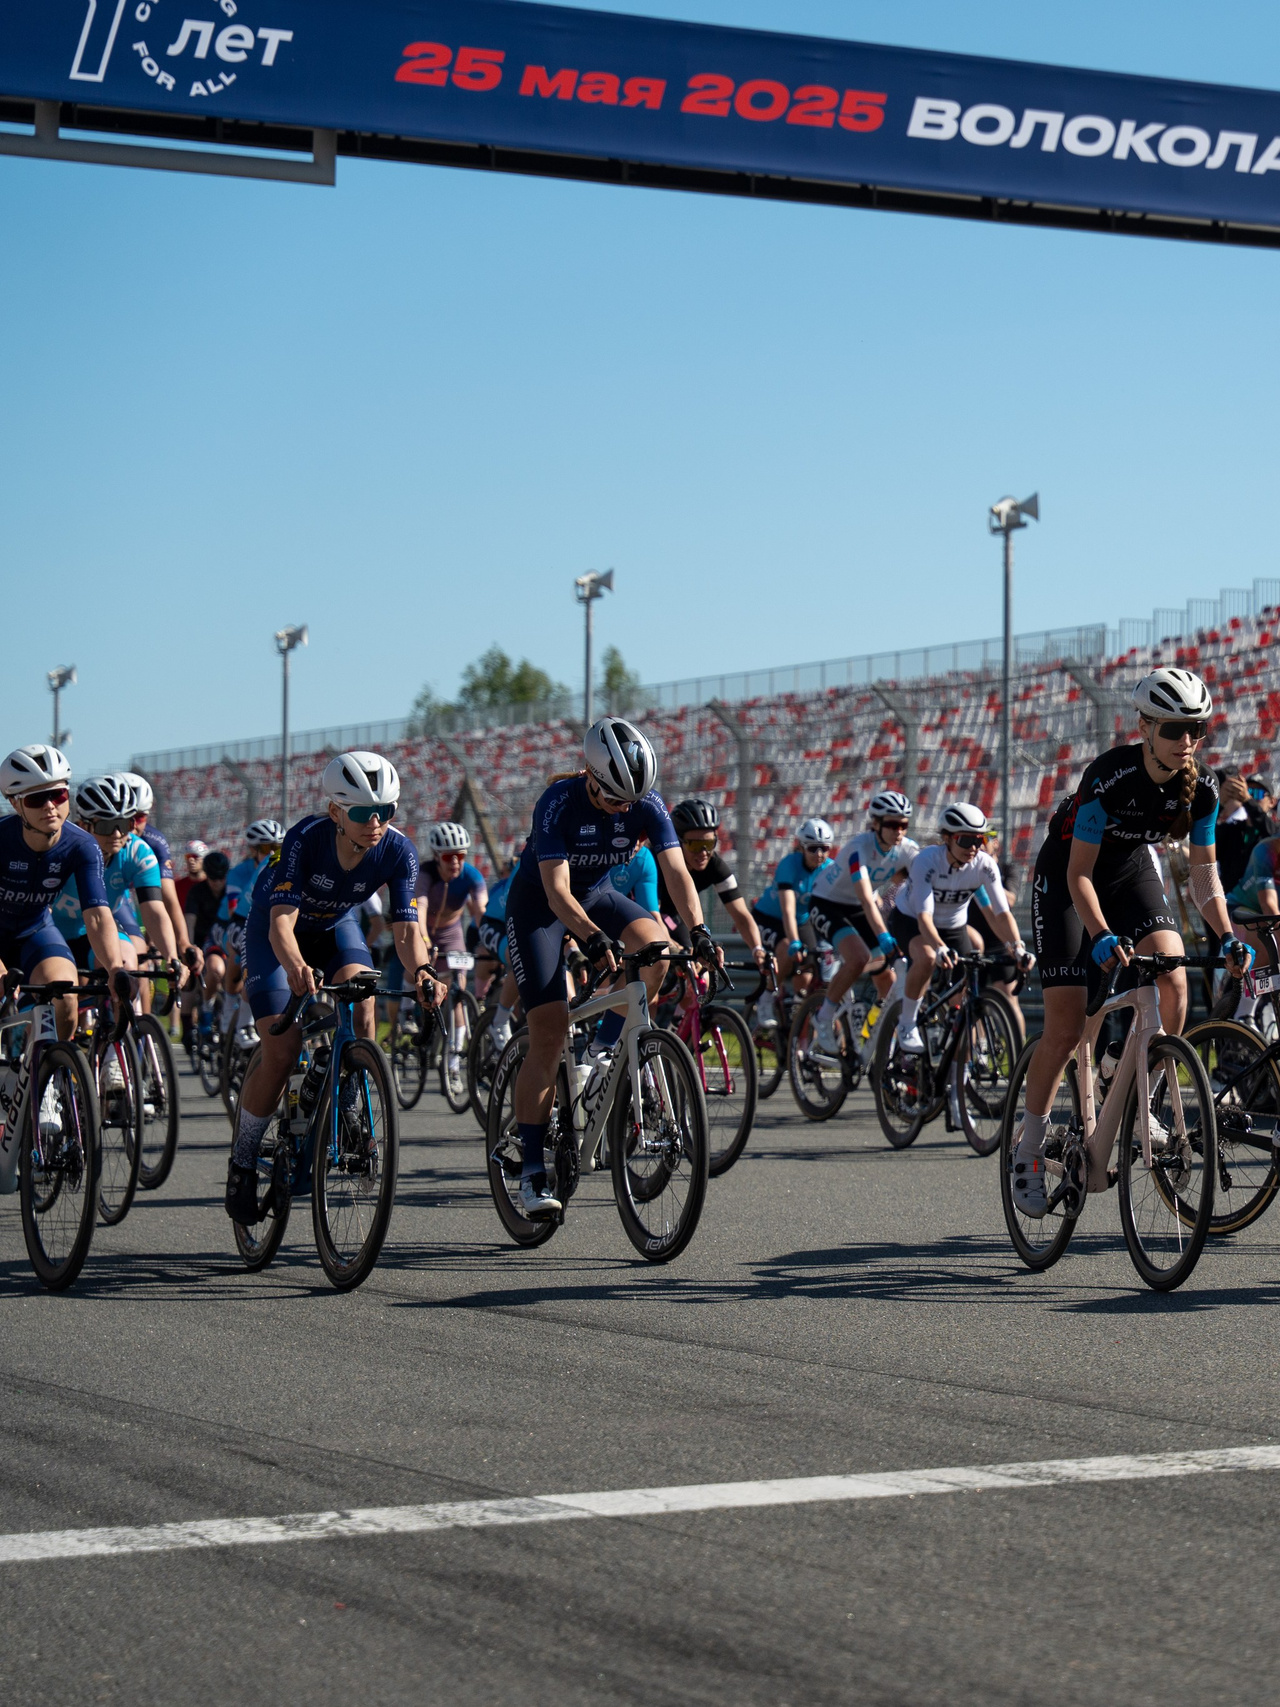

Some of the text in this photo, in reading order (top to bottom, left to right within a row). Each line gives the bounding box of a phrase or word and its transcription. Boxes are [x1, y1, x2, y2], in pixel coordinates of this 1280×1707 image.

[166, 18, 294, 66] лет
[132, 41, 237, 97] FOR ALL
[395, 41, 506, 92] 25
[519, 64, 667, 110] мая
[680, 73, 888, 133] 2025
[1094, 765, 1137, 794] VolgaUnion
[543, 791, 570, 834] ARCHPLAY
[647, 791, 672, 821] CHPLAY
[1114, 809, 1144, 817] AURUM
[933, 889, 971, 902] RED
[809, 906, 831, 938] RCA
[1034, 874, 1044, 954] VolgaUnion
[1135, 915, 1175, 937] AURU
[506, 916, 526, 985] SERPANTIN
[1260, 979, 1270, 990] 015
